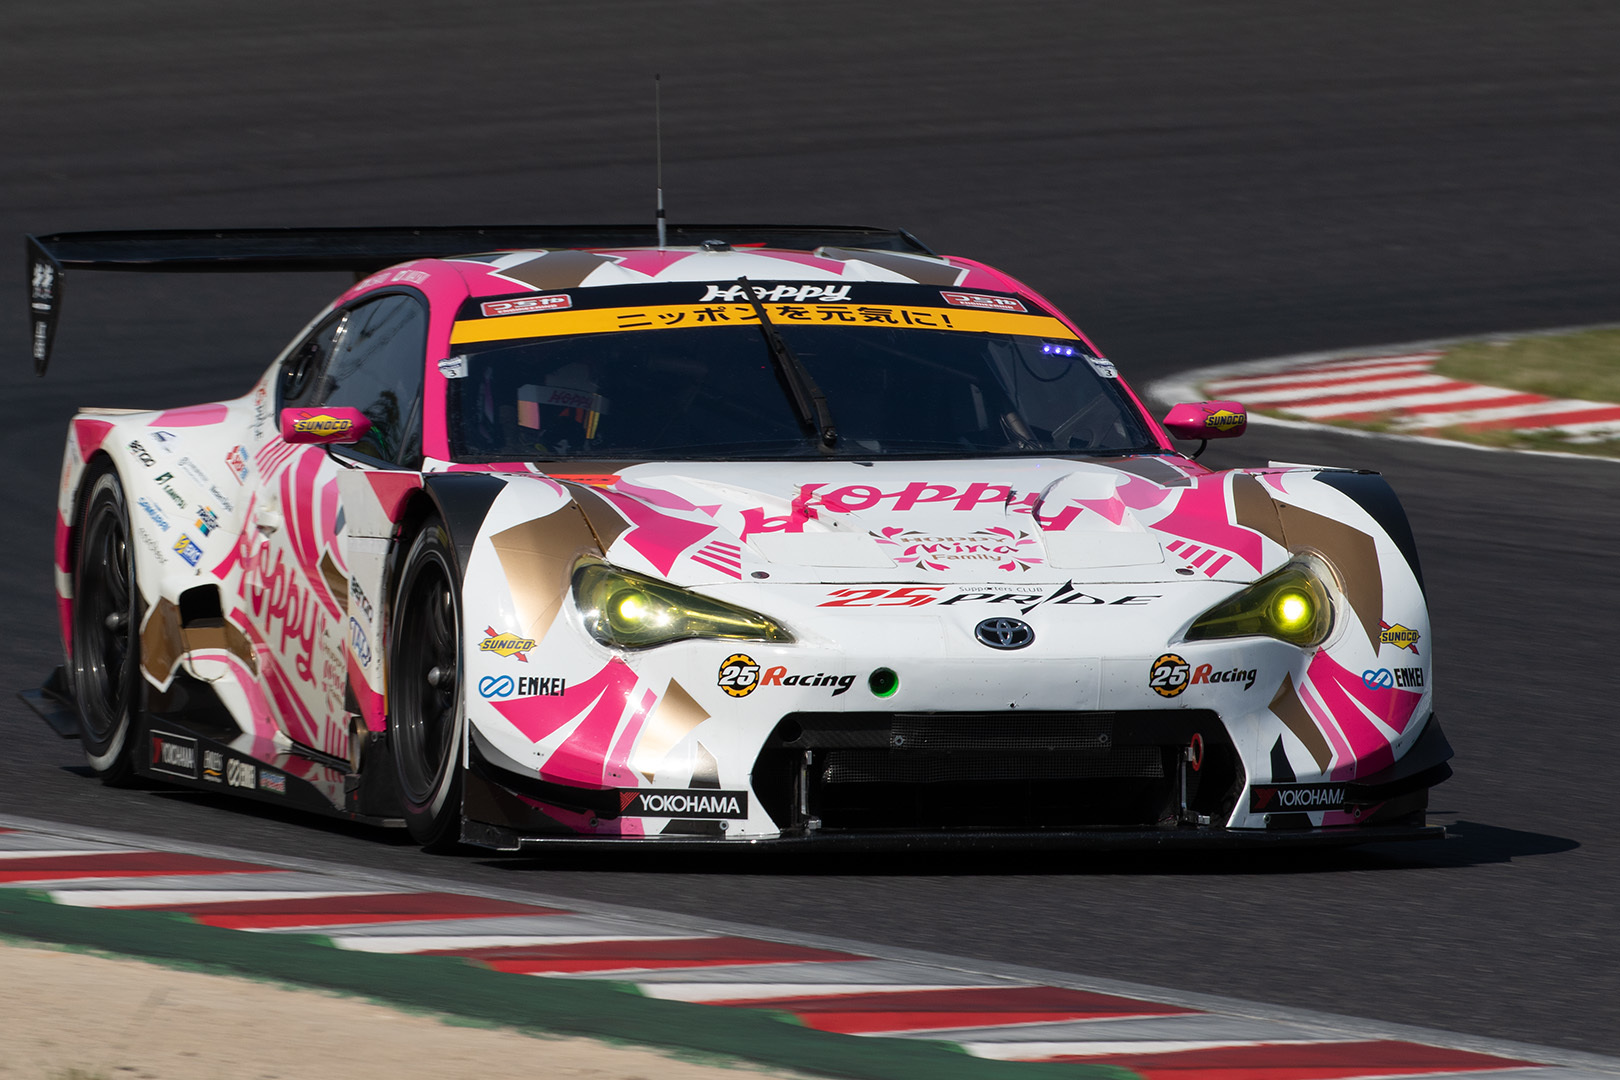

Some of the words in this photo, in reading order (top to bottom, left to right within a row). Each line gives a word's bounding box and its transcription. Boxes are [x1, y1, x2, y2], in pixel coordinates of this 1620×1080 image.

[699, 285, 852, 302] Hoppy
[298, 420, 349, 431] SUNOCO
[1207, 414, 1245, 426] SUNOCO
[932, 554, 1002, 562] Family
[482, 639, 533, 650] SUNOCO
[1381, 631, 1418, 643] SUNOCO
[718, 665, 760, 687] 25
[760, 665, 856, 697] Racing
[1150, 665, 1190, 687] 25
[1190, 663, 1257, 691] Racing
[1393, 667, 1424, 688] ENKEI
[517, 676, 566, 697] ENKEI
[639, 794, 741, 814] YOKOHAMA
